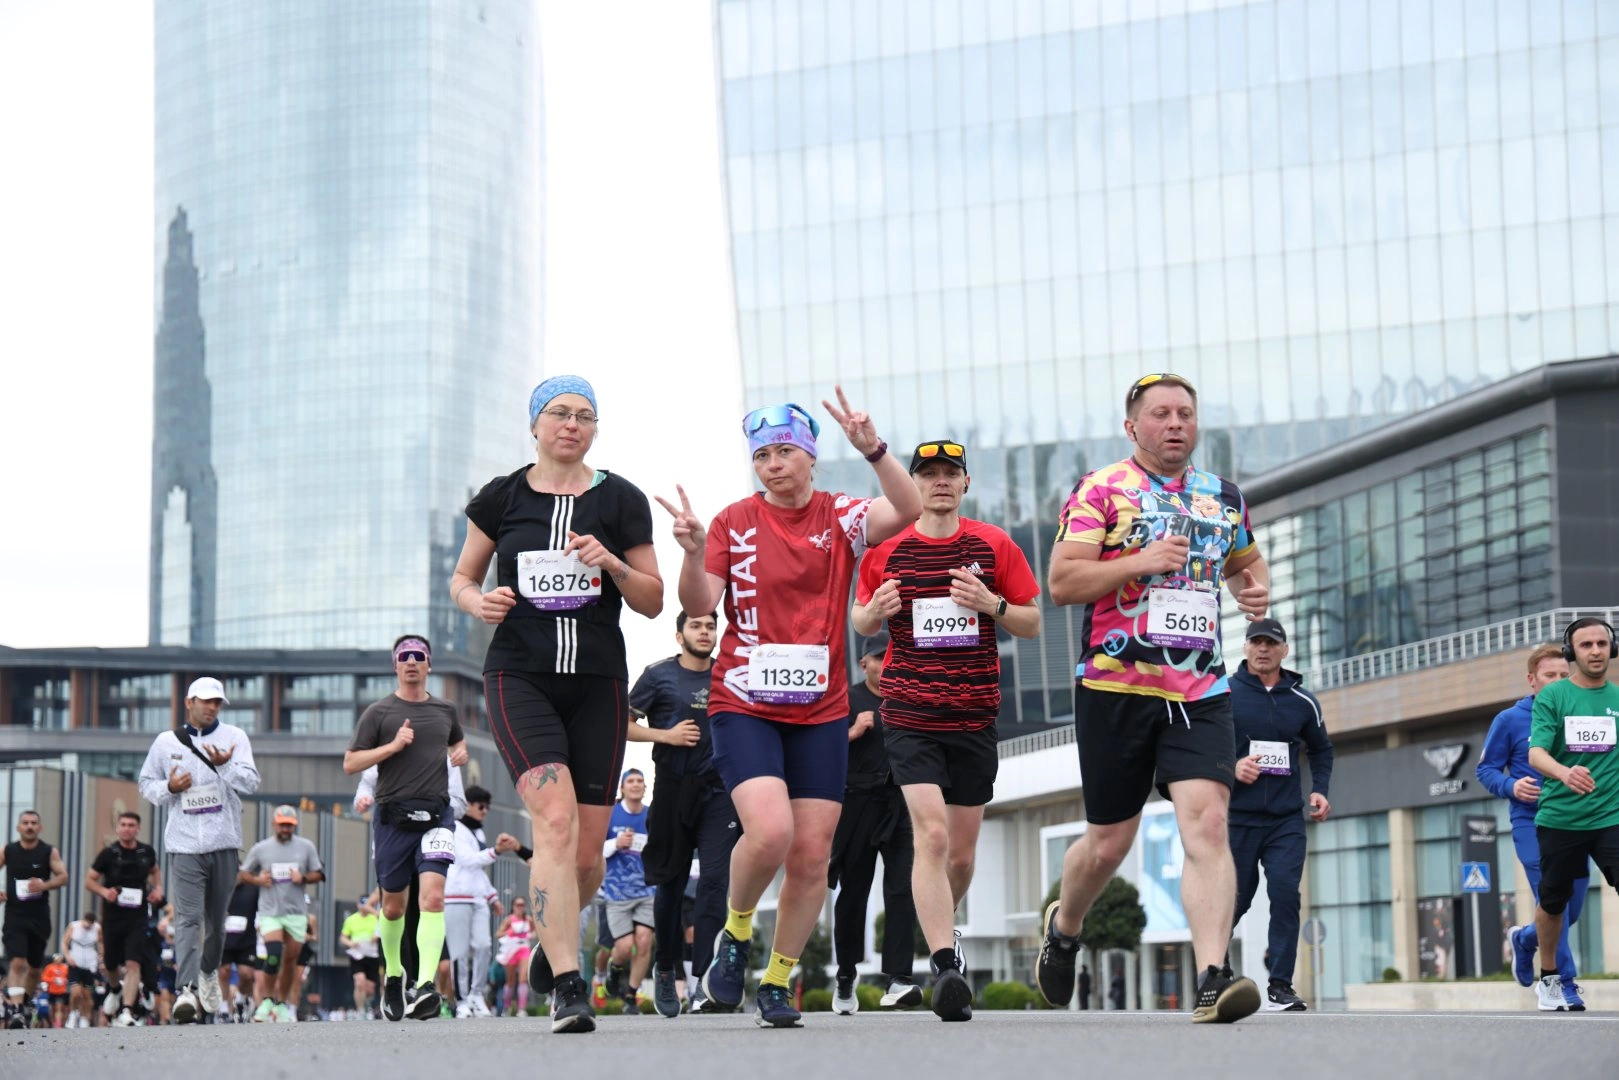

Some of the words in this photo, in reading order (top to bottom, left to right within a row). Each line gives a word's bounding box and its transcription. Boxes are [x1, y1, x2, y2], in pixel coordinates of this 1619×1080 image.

[529, 573, 590, 592] 16876
[923, 617, 967, 632] 4999
[1165, 613, 1207, 632] 5613
[761, 669, 817, 686] 11332
[1576, 731, 1606, 742] 1867
[187, 795, 218, 807] 16896
